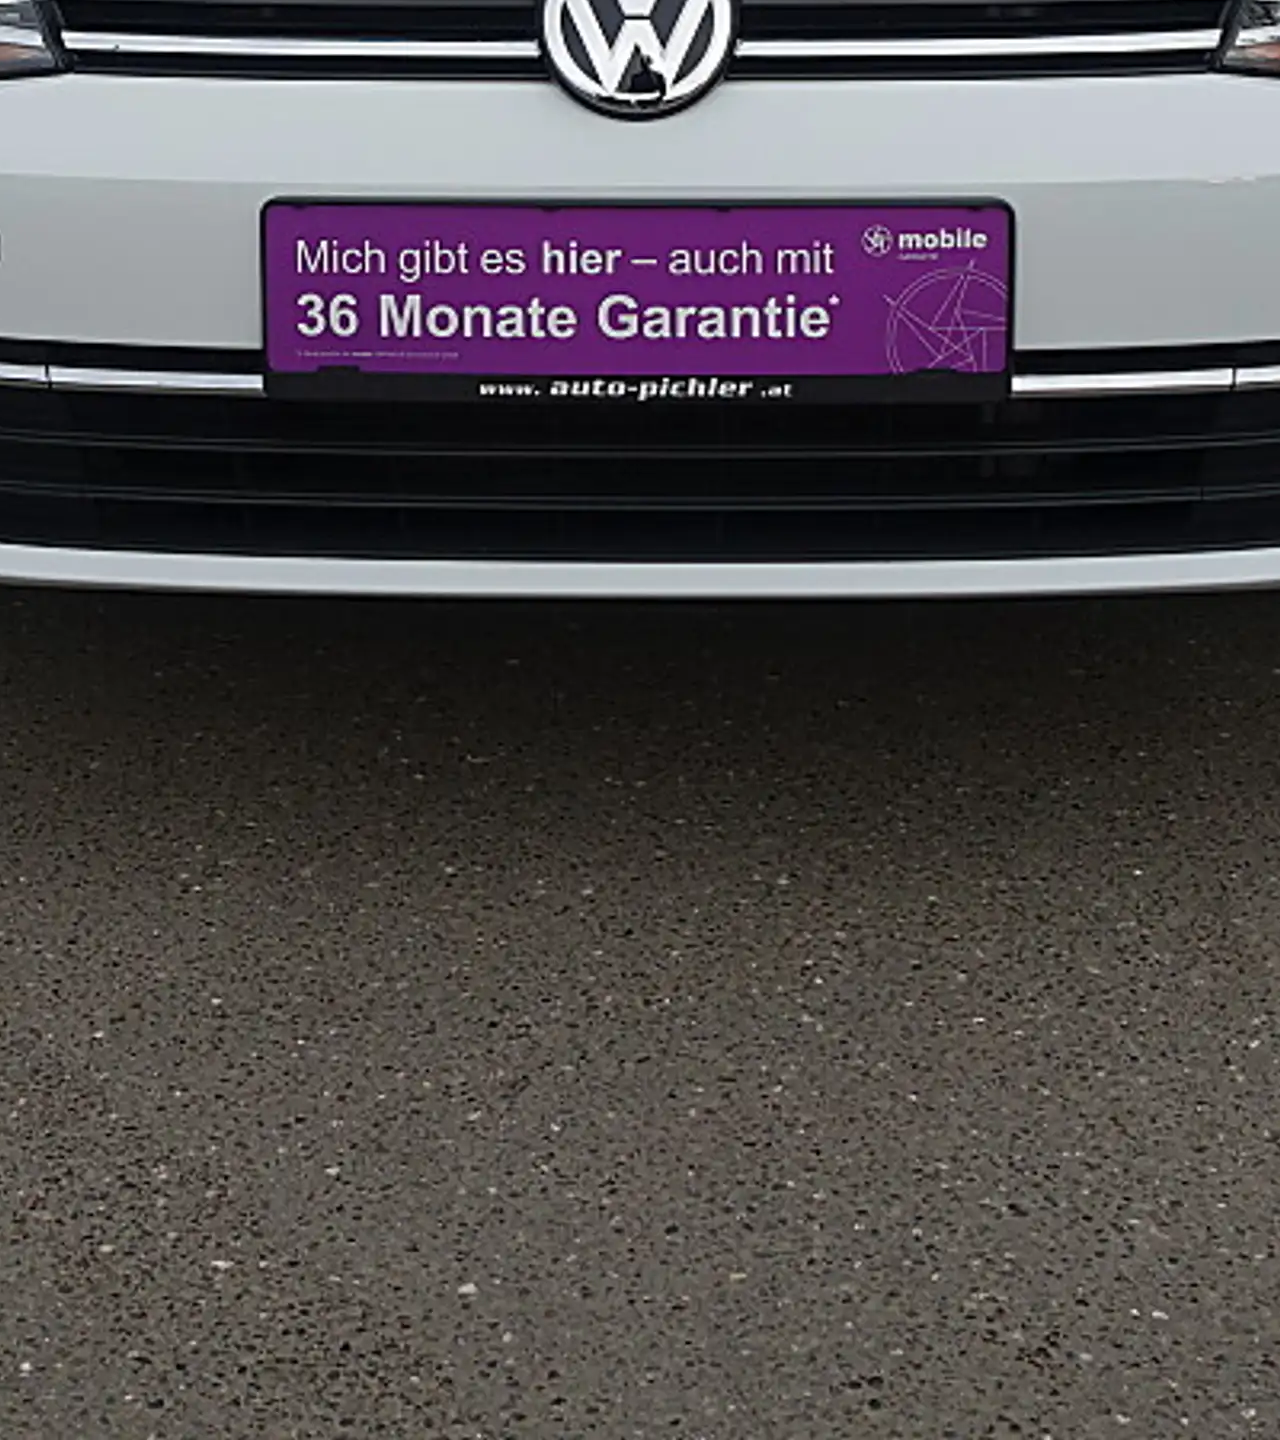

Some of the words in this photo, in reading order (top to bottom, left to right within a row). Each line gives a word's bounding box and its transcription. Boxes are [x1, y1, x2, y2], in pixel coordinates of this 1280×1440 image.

[898, 227, 988, 250] mobile
[296, 240, 386, 274] Mich
[398, 240, 470, 283] gibt
[480, 248, 526, 274] es
[542, 240, 622, 274] hier
[668, 241, 763, 275] auch
[776, 241, 835, 275] mit
[296, 294, 360, 338] 36
[379, 294, 578, 340] Monate
